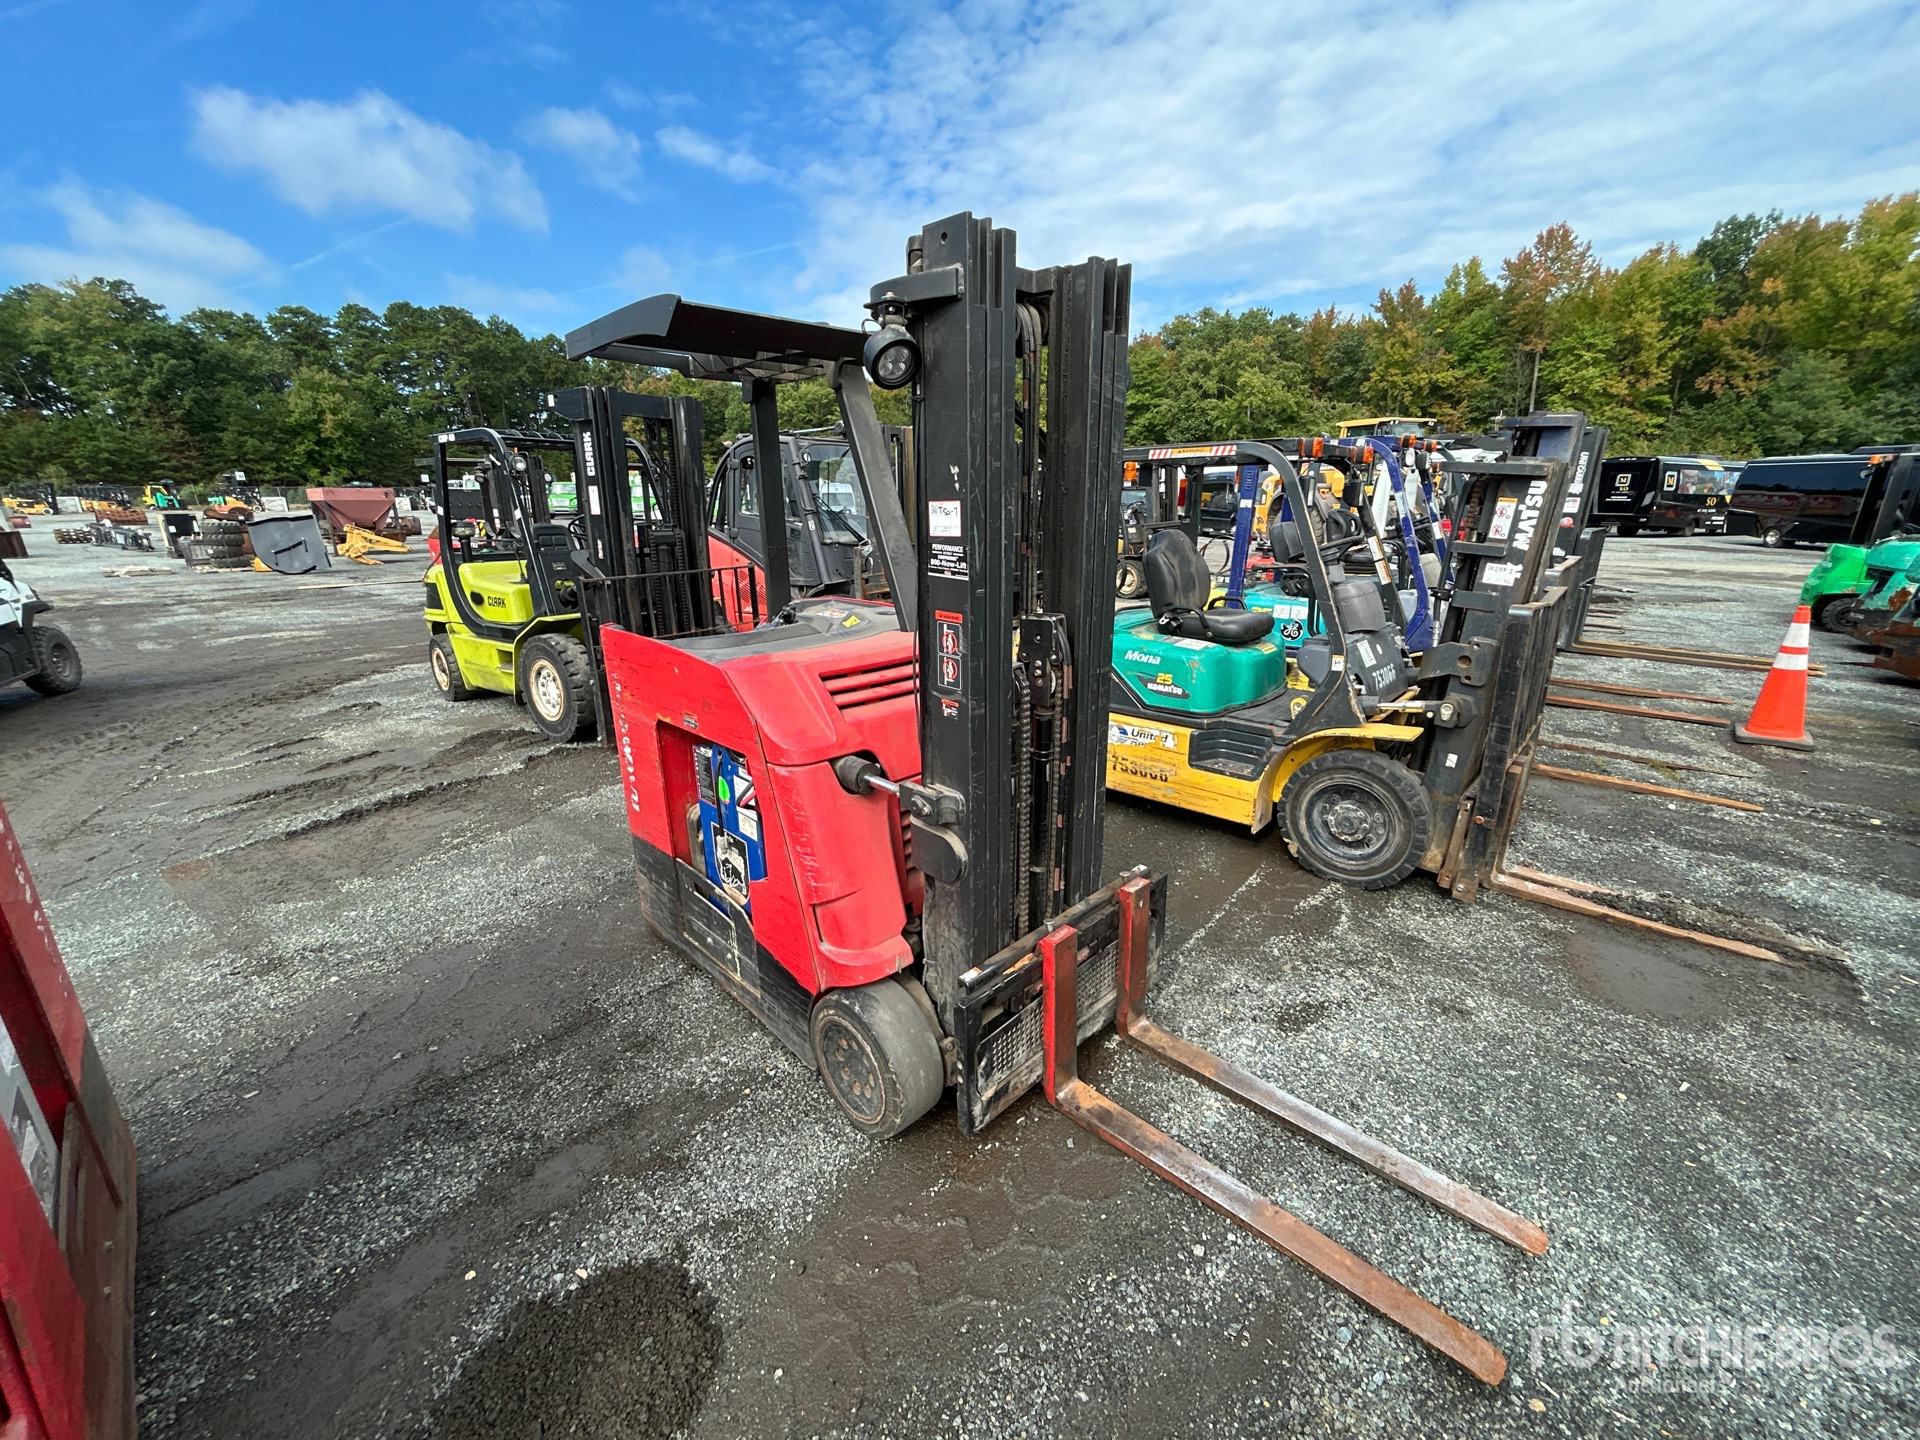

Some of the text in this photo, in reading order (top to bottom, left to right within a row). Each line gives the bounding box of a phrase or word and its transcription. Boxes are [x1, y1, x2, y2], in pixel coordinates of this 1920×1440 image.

[582, 431, 596, 477] CLARK
[931, 543, 964, 553] PERFORMANCE
[487, 595, 507, 608] CLARK
[1124, 649, 1162, 666] Mona
[1156, 672, 1174, 685] 25
[1147, 682, 1183, 696] KOMATSU
